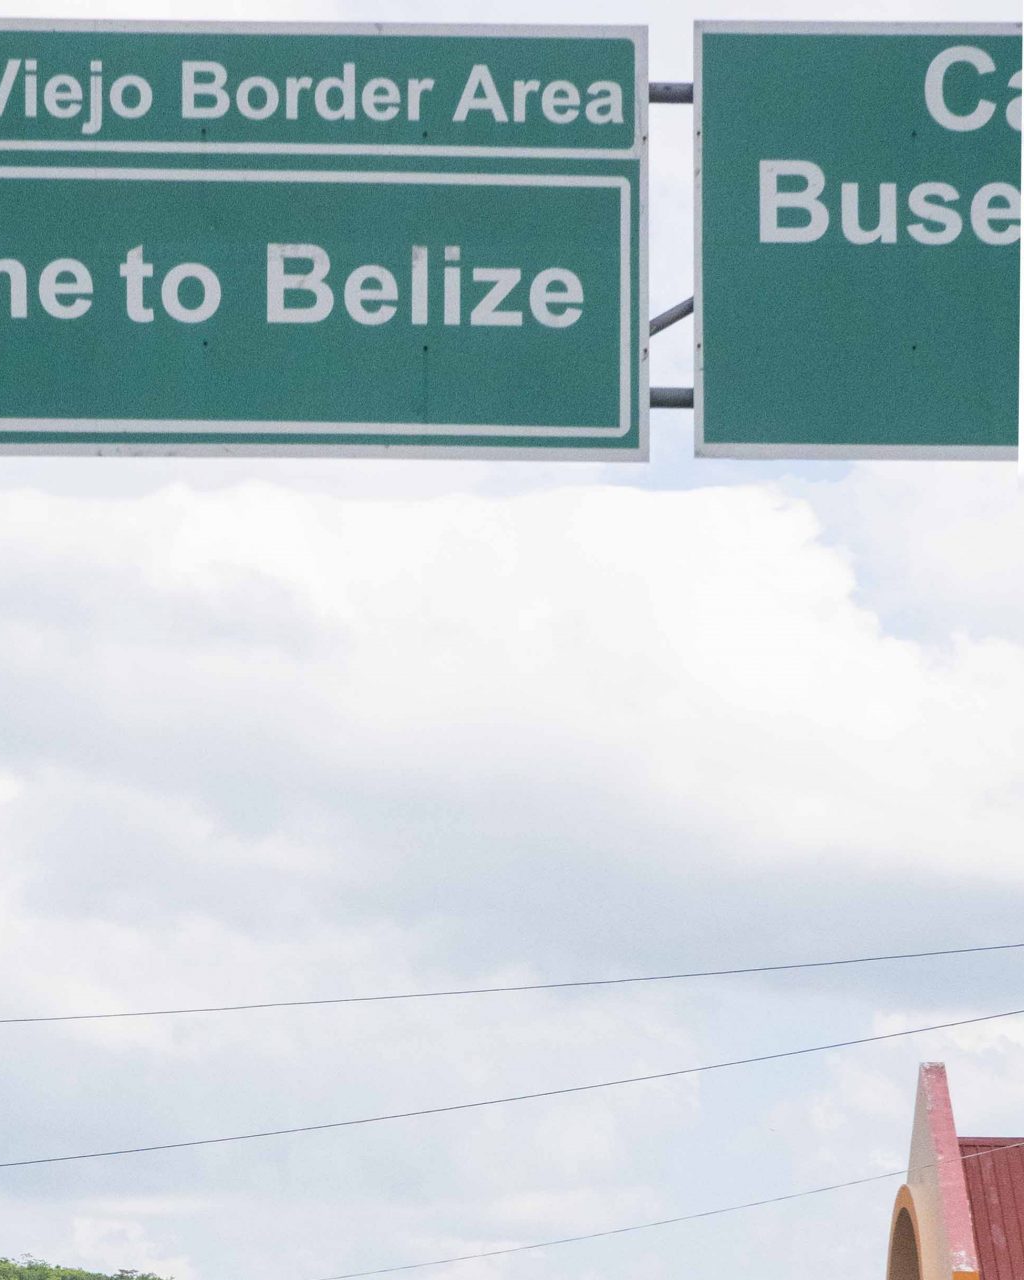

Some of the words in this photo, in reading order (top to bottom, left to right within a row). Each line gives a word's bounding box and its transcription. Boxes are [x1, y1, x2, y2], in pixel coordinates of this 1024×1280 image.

[181, 60, 435, 122] Border
[450, 63, 625, 125] Area
[923, 44, 1023, 133] C
[758, 158, 1022, 246] Buse
[119, 243, 223, 325] to
[265, 242, 586, 329] Belize
